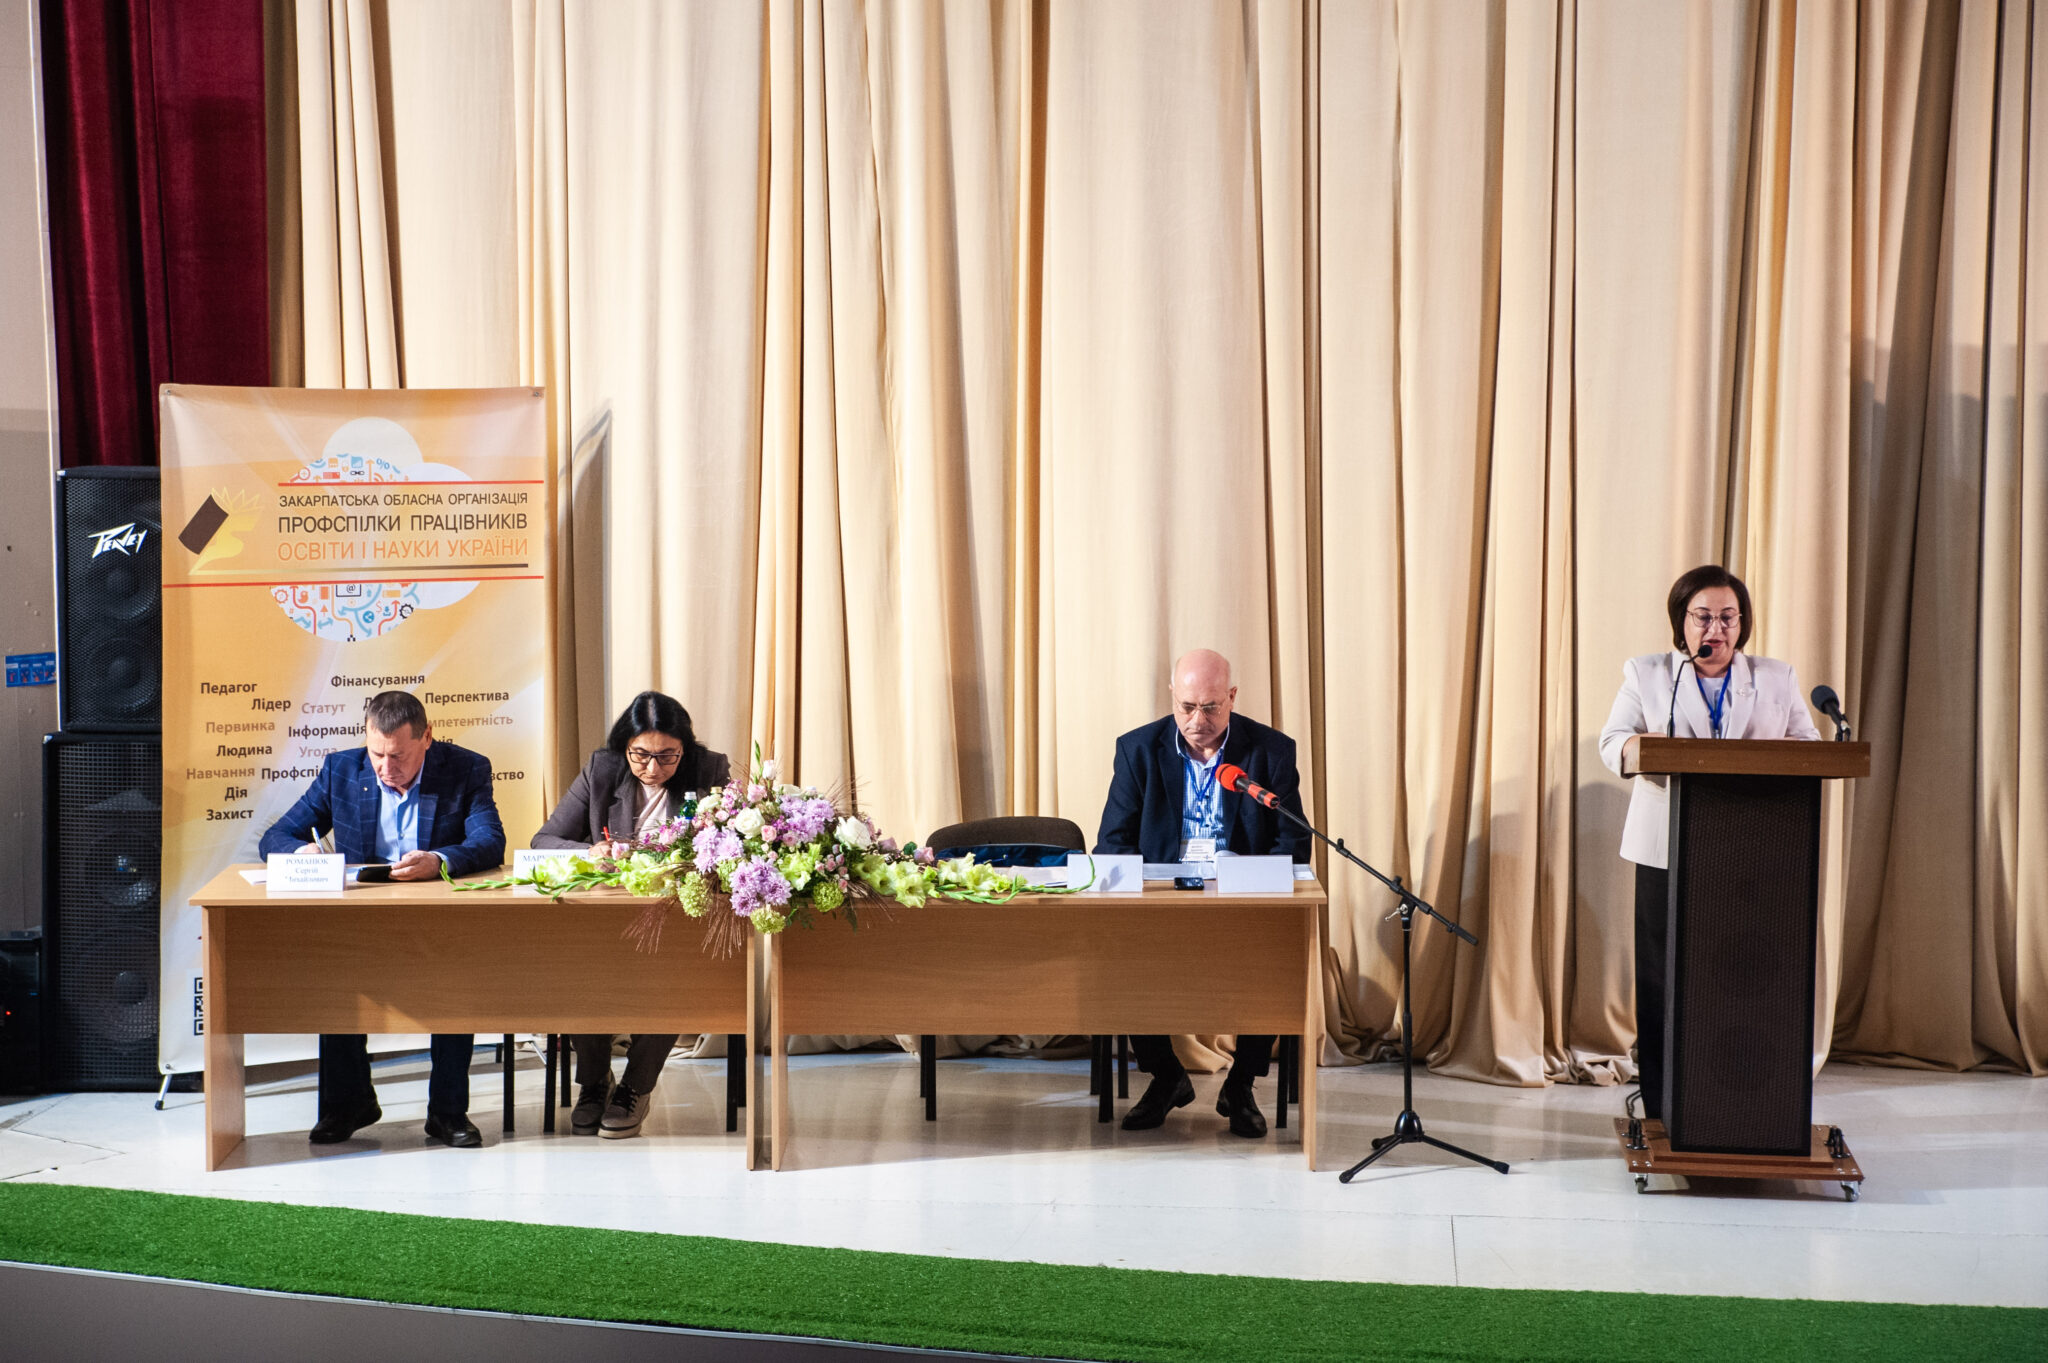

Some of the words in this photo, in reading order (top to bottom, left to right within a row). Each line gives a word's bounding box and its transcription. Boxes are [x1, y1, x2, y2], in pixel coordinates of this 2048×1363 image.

[279, 494, 379, 508] ЗАКАРПАТСЬКА
[383, 493, 443, 507] ОБЛАСНА
[448, 492, 528, 506] ОРГАНІЗАЦІЯ
[278, 515, 401, 533] ПРОФСПІЛКИ
[410, 513, 528, 533] ПРАЦІВНИКІВ
[277, 541, 354, 561] ОСВІТИ
[373, 539, 439, 559] НАУКИ
[447, 535, 528, 557] УКРАЇНИ
[200, 682, 258, 695] Педагог
[331, 674, 425, 689] Фінансування
[251, 698, 292, 712] Лідер
[425, 691, 510, 706] Перспектива
[301, 702, 346, 715] Статут
[206, 721, 276, 735] Первинка
[428, 713, 514, 728] мпетентність
[288, 722, 367, 738] Інформація
[216, 744, 273, 758] Людина
[186, 766, 256, 780] Навчання
[261, 765, 323, 782] Профспі
[224, 786, 248, 801] Дія
[206, 808, 254, 821] Захист
